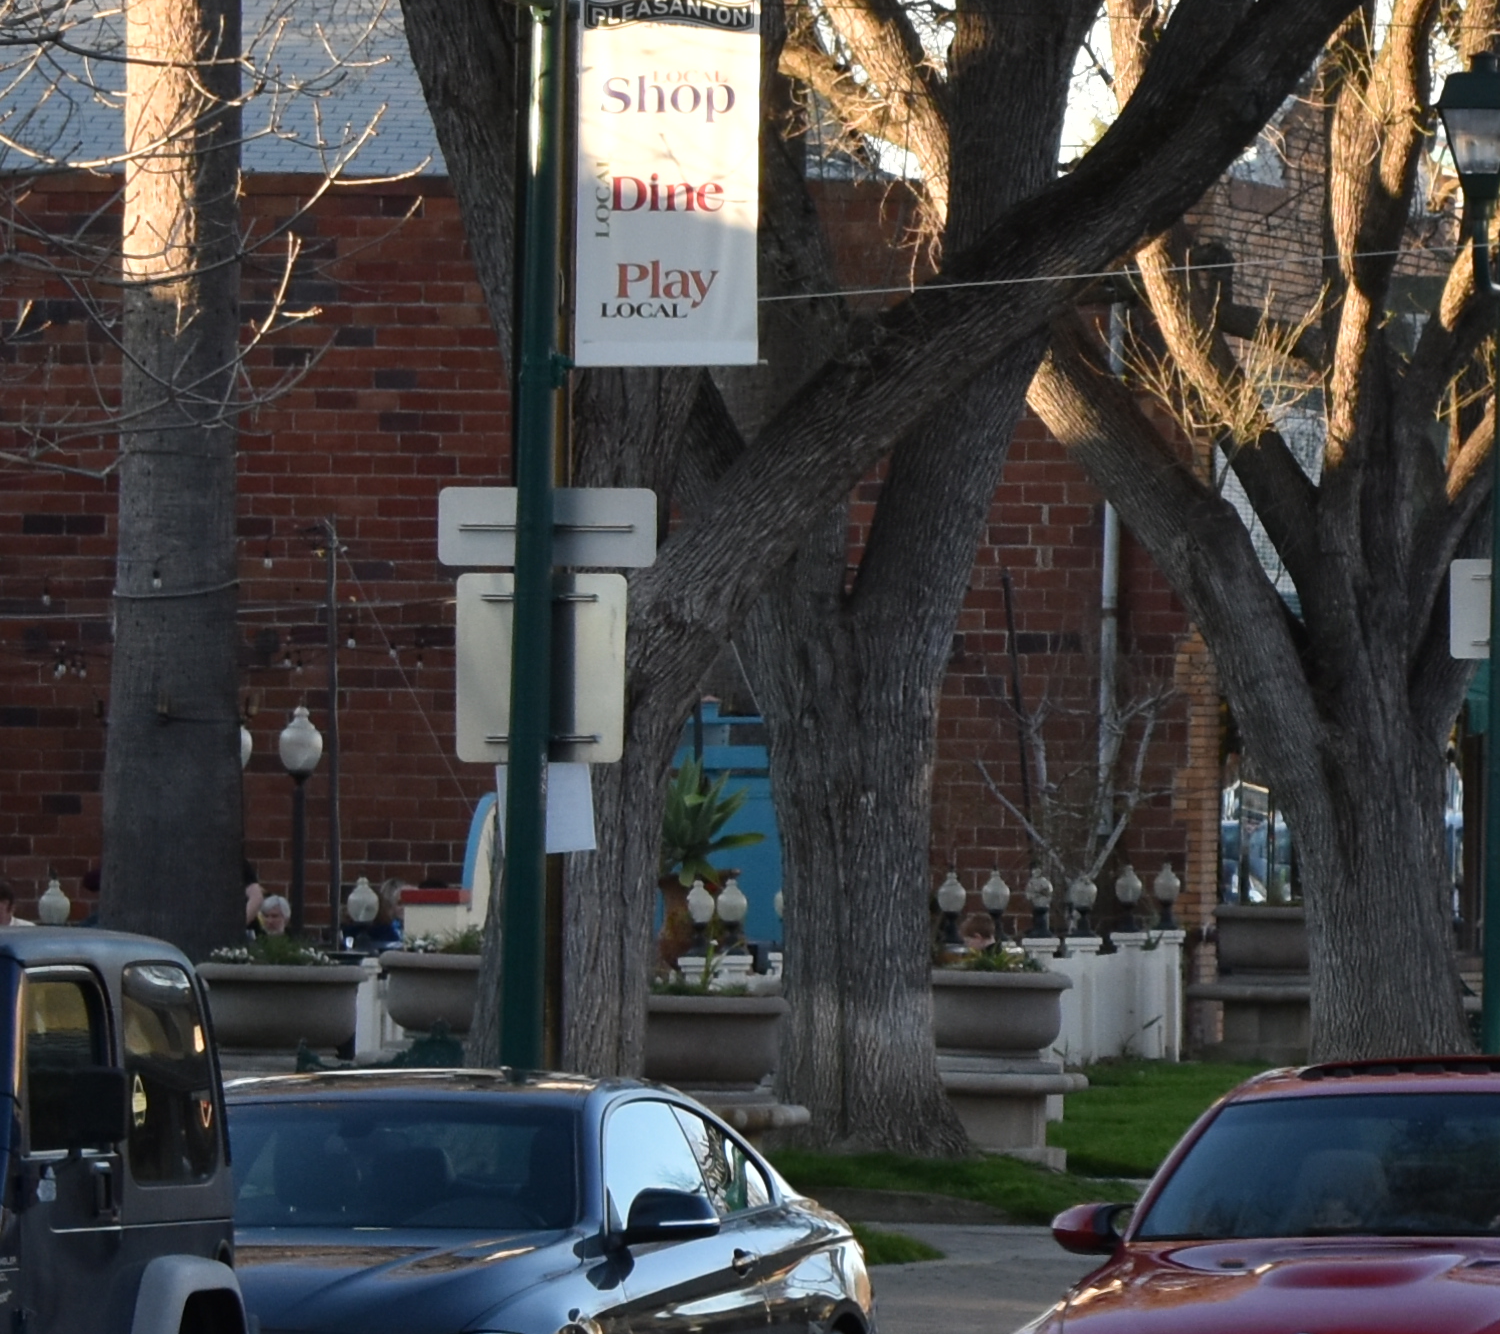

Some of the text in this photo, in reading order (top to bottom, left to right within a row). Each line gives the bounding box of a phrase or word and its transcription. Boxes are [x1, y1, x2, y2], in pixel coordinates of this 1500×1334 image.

[600, 75, 736, 123] Shop
[611, 172, 725, 212] Dine
[615, 259, 719, 309] Play
[600, 302, 688, 318] LOCAL
